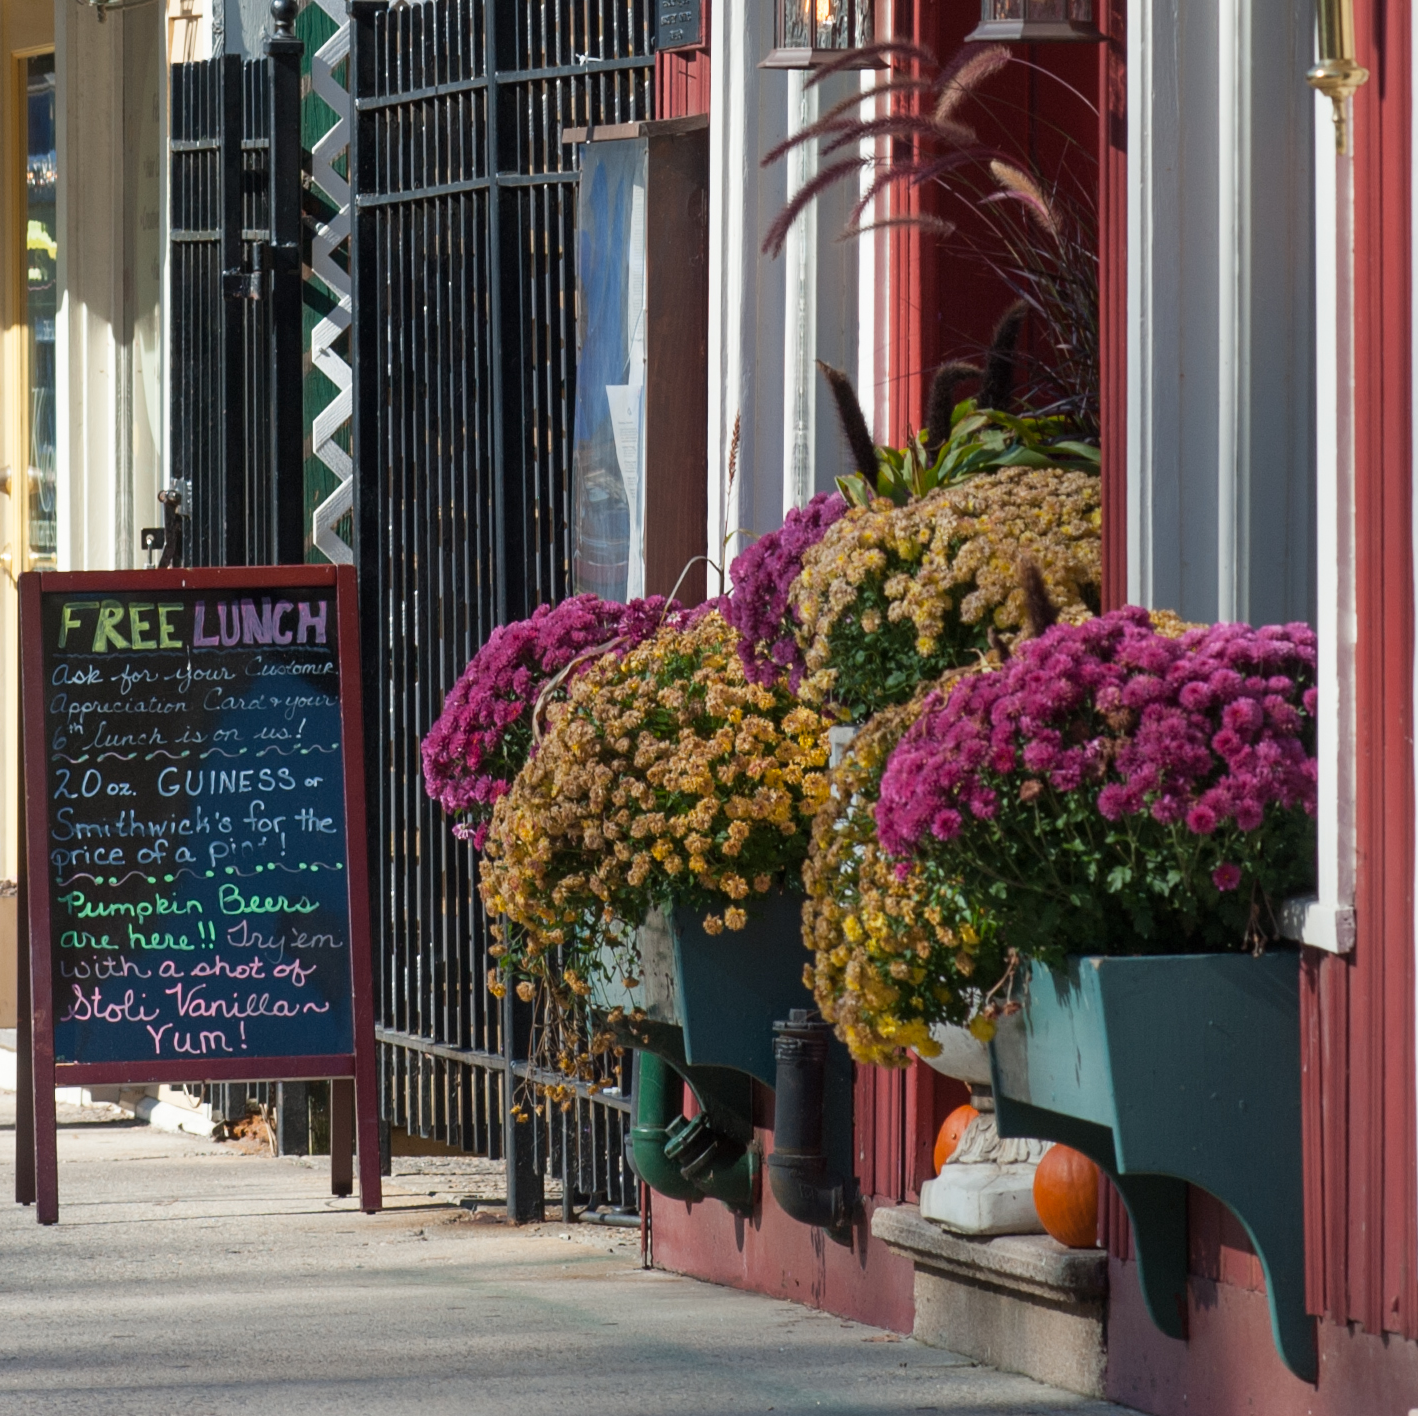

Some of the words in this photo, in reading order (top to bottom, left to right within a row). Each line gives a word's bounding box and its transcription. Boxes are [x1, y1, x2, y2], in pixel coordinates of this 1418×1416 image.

[58, 599, 185, 653] FREE
[192, 596, 328, 648] LUNCH
[51, 663, 104, 685] Ask
[110, 664, 160, 695] for
[163, 666, 237, 693] your
[244, 656, 339, 678] Customer
[50, 693, 188, 725] Appreciation
[202, 686, 268, 711] Card
[281, 695, 339, 720] your
[52, 722, 84, 750] 6th
[83, 720, 168, 751] lunch
[175, 725, 209, 744] is
[213, 728, 241, 742] on
[53, 768, 102, 800] 20
[106, 782, 137, 797] oz.
[157, 766, 297, 797] GUINESS
[303, 776, 324, 787] or
[51, 805, 233, 842] Smithwick's
[243, 799, 287, 833] for
[293, 807, 338, 834] the
[51, 844, 126, 876] price
[137, 838, 169, 865] of
[175, 847, 197, 864] a
[57, 890, 203, 925] Pumpkin
[218, 883, 320, 915] Beers
[60, 929, 119, 949] are
[128, 920, 216, 950] here!!
[227, 919, 285, 965] Try
[60, 955, 152, 979] with
[158, 960, 185, 978] a
[190, 955, 266, 979] shot
[272, 958, 318, 987] of
[60, 983, 160, 1022] Stoli
[165, 982, 301, 1019] Vanilla
[146, 1020, 249, 1055] Yum!
